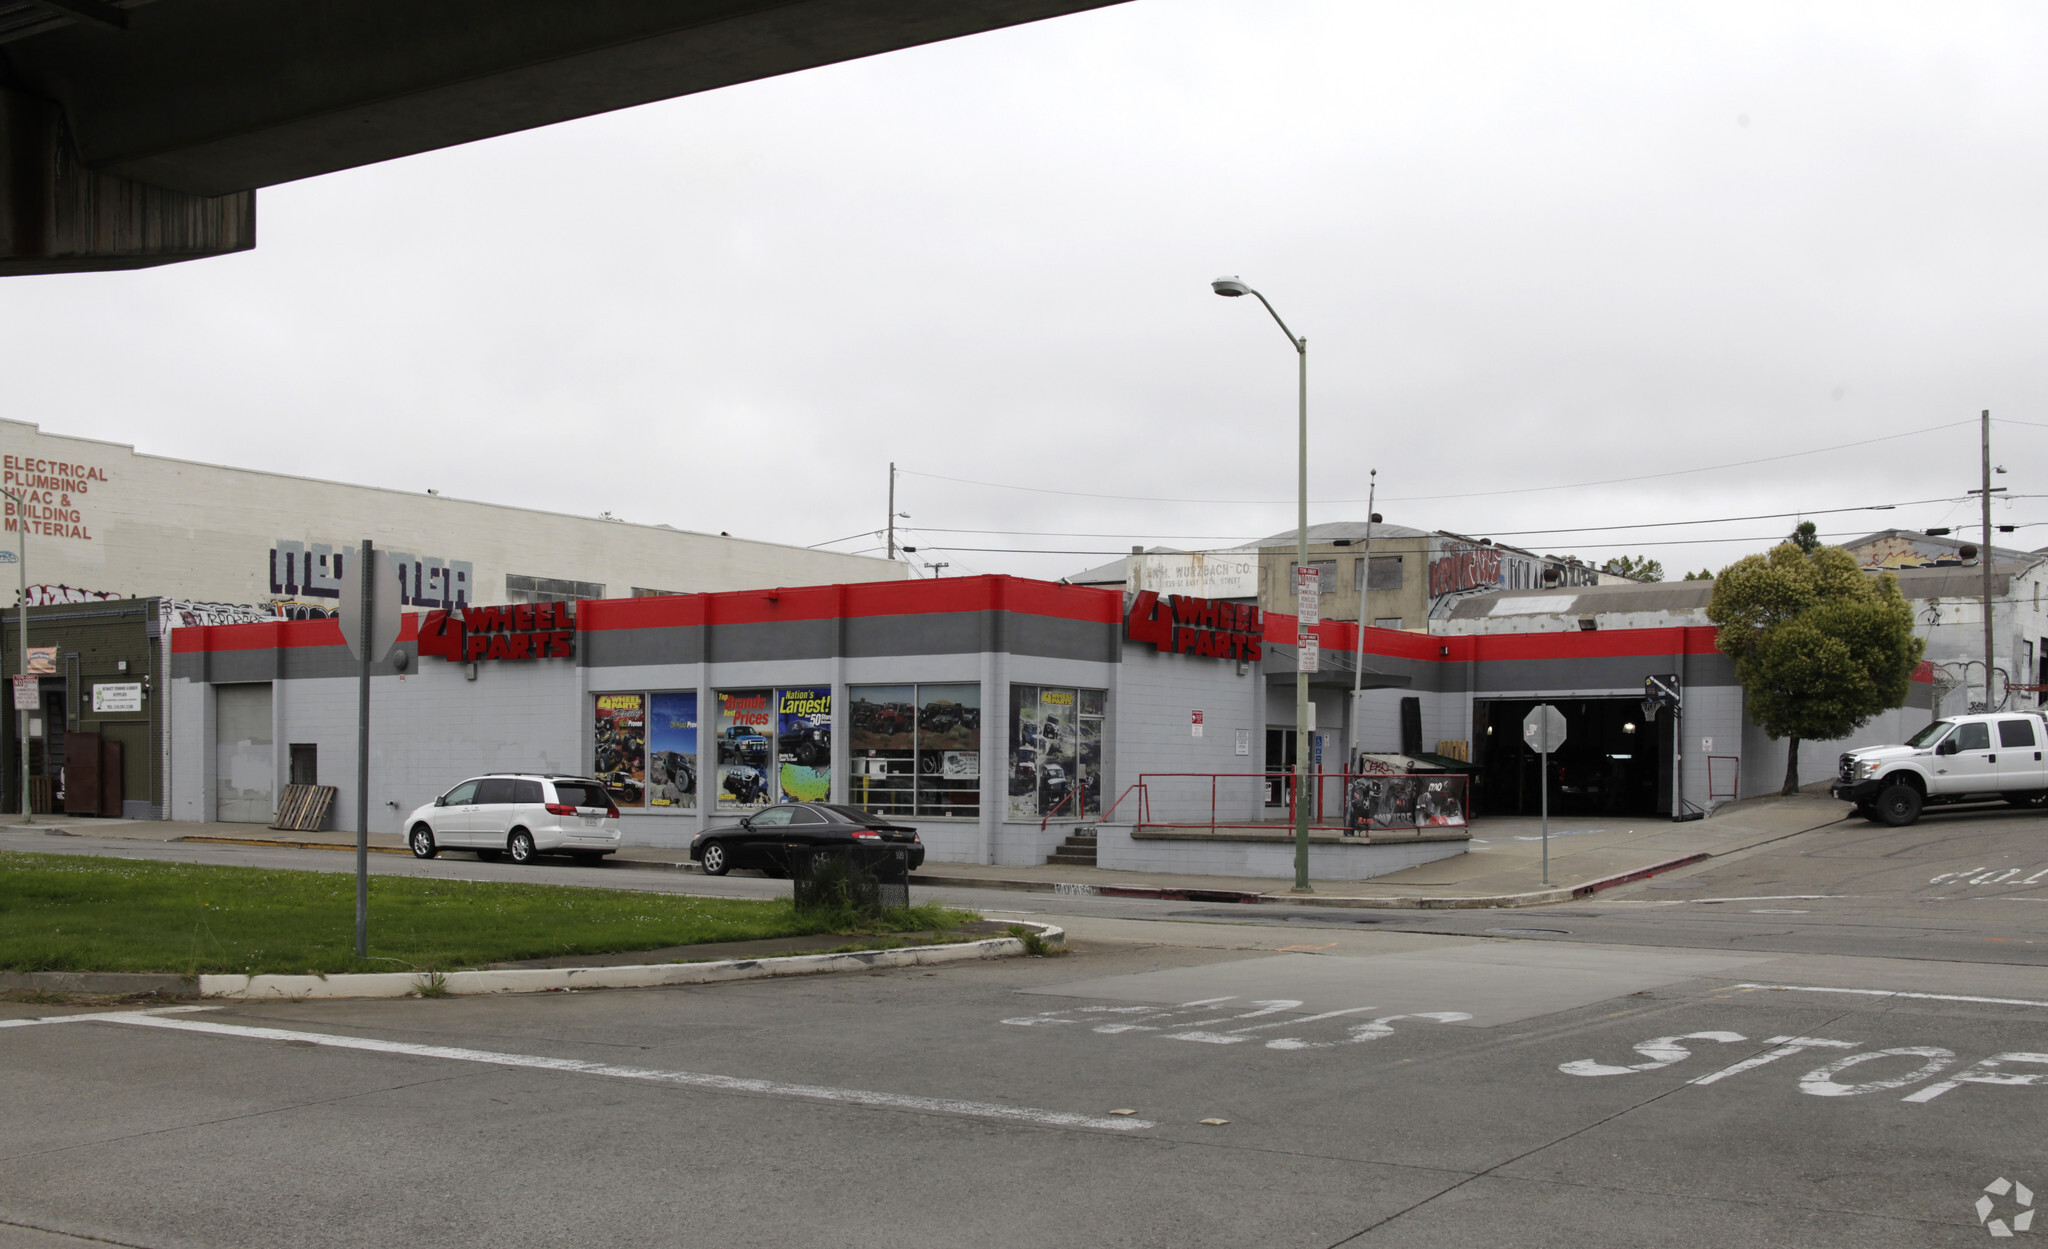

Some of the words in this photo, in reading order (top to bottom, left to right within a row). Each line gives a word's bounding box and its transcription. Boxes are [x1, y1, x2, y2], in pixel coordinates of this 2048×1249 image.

[4, 455, 108, 482] ELECTRICAL
[4, 471, 88, 494] PLUMBING
[5, 487, 53, 504] HVAC
[60, 494, 71, 507] &
[5, 502, 80, 523] BUILDING
[5, 518, 92, 540] MATERIAL
[1176, 564, 1229, 578] WURZBACH
[1127, 590, 1173, 652] 4
[1169, 594, 1265, 632] WHEEL
[418, 610, 463, 662] 4
[462, 602, 573, 632] WHEEL
[468, 631, 570, 662] PARTS
[1174, 626, 1262, 662] PARTS
[598, 696, 611, 709] 4
[719, 693, 728, 701] Top
[725, 694, 766, 710] Brands
[786, 690, 814, 700] Nation's
[780, 696, 831, 717] Largest!
[733, 711, 769, 725] Prices
[810, 714, 821, 726] 50
[1558, 1030, 2048, 1103] STOP
